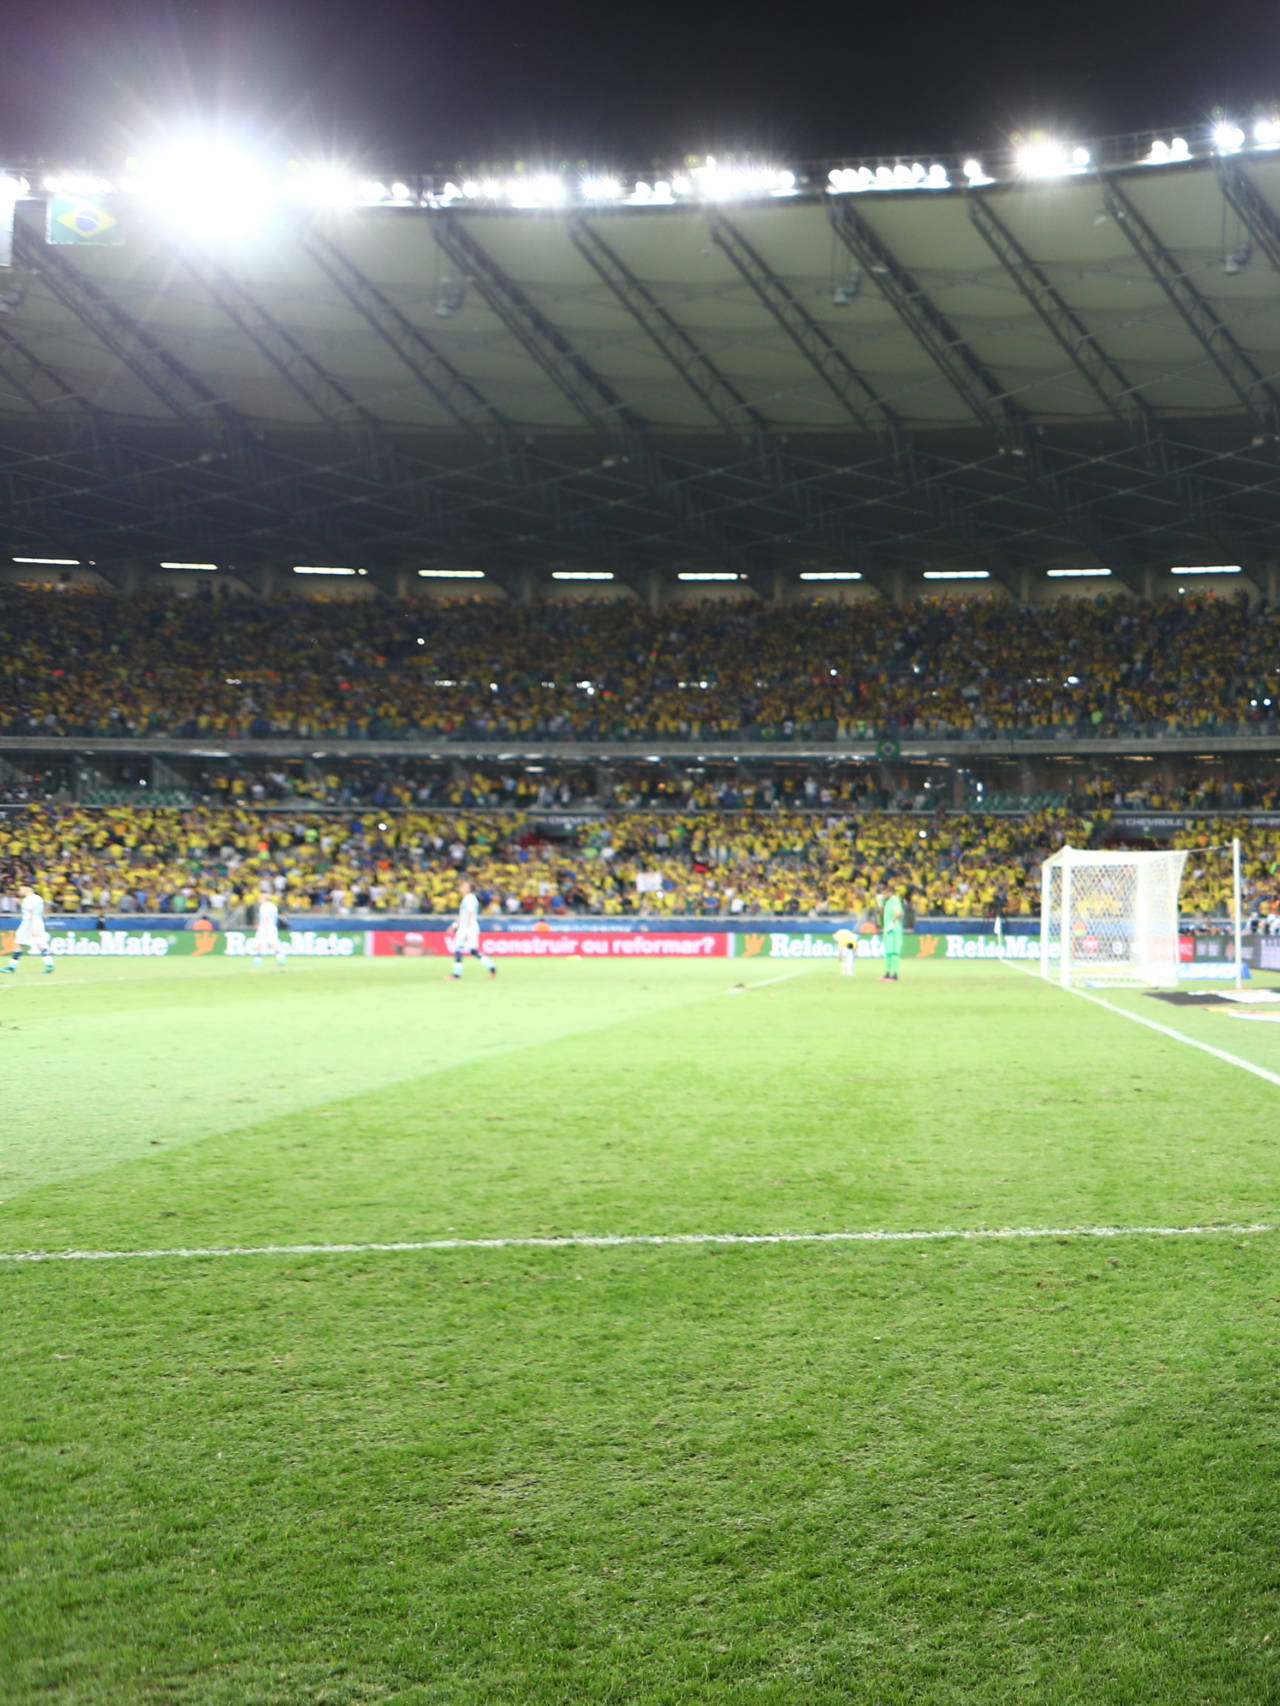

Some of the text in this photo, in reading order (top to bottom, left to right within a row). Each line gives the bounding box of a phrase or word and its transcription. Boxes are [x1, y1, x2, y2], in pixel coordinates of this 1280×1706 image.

[1125, 818, 1183, 827] CHEVROLE
[28, 931, 169, 956] eidoMate
[482, 936, 579, 955] construir
[581, 940, 609, 955] ou
[769, 933, 886, 958] Reidoat
[945, 935, 1064, 960] ReidoMae
